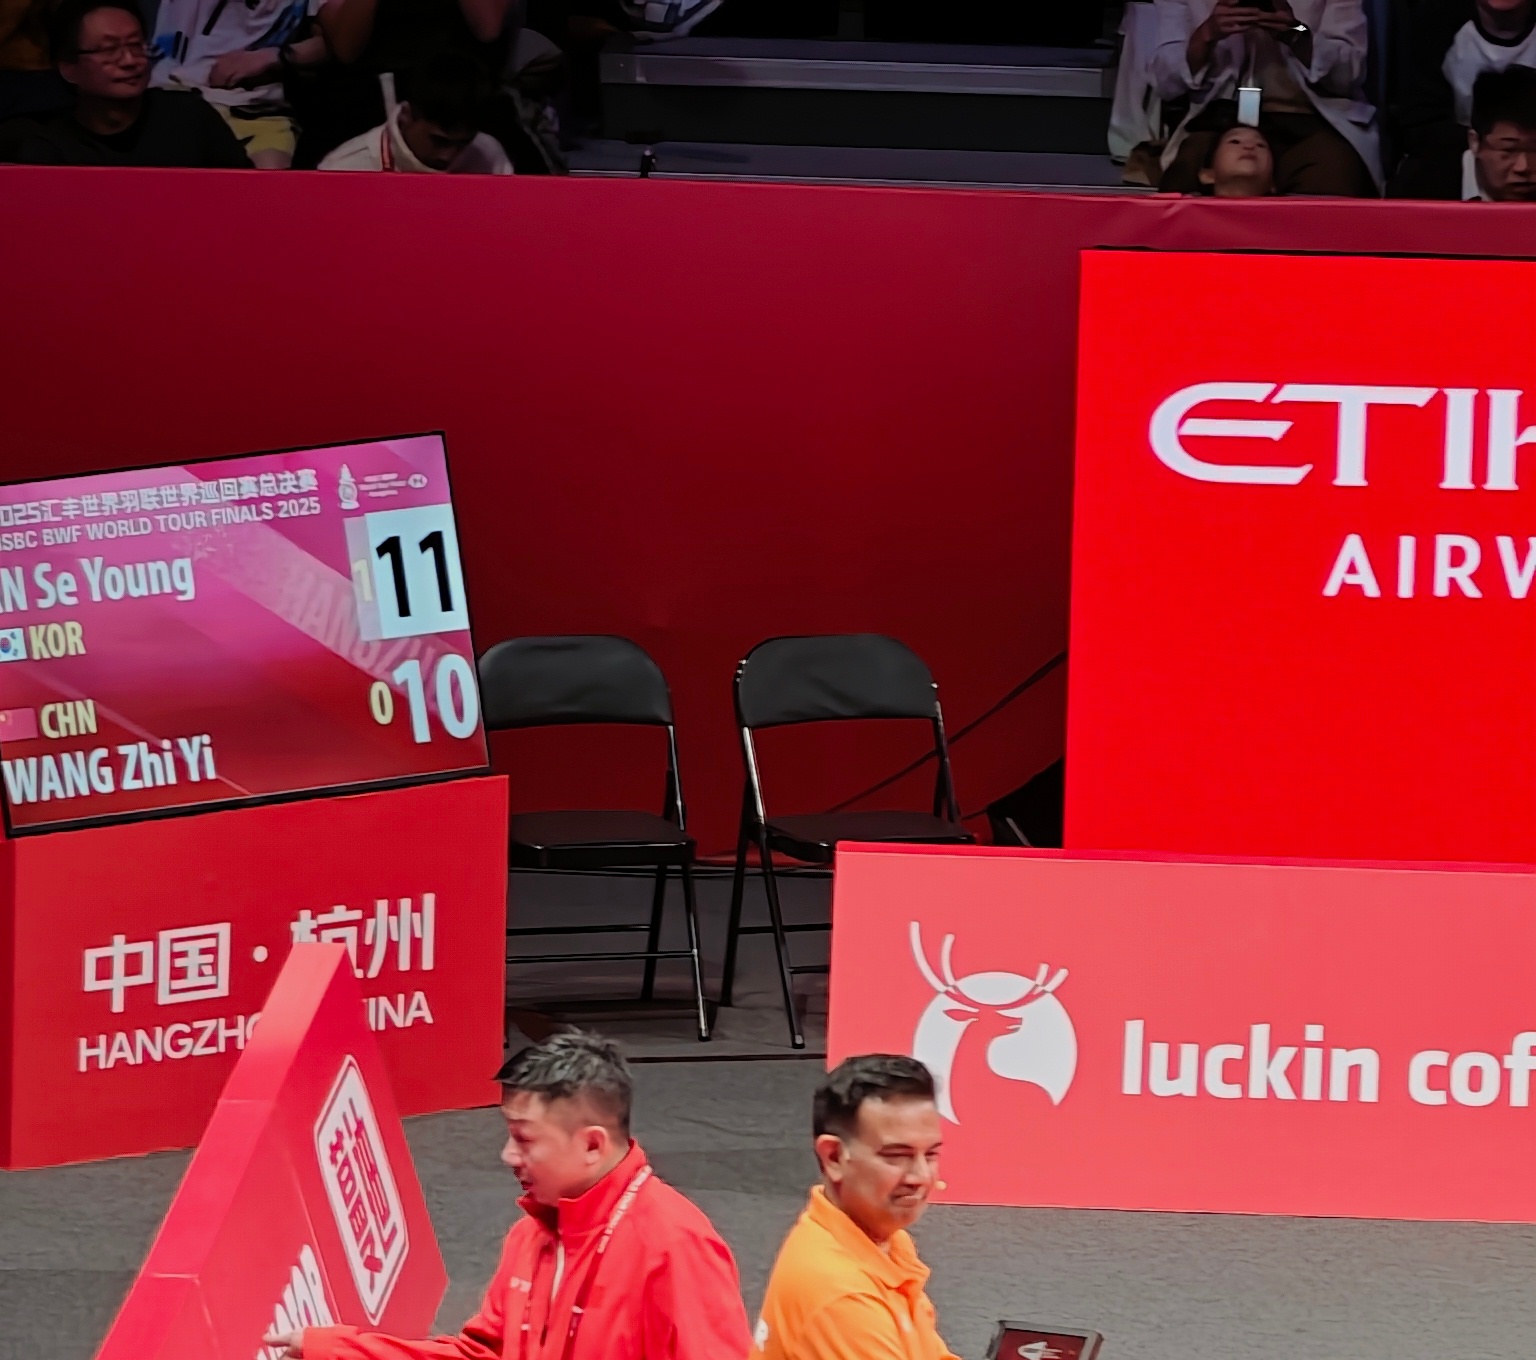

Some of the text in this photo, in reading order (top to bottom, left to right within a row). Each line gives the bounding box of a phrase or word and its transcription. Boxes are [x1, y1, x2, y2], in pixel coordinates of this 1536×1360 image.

[42, 524, 82, 546] BWF
[86, 517, 153, 541] WORLD
[155, 509, 208, 534] TOUR
[212, 502, 275, 526] FINALS
[277, 496, 321, 519] 2025
[35, 562, 78, 607] Se
[79, 556, 196, 603] Young
[375, 530, 455, 618] 11
[29, 621, 86, 660] KOR
[40, 699, 98, 739] CHN
[369, 653, 479, 745] 0 10
[0, 734, 217, 806] WANG Zhi Yi
[84, 893, 436, 1013] 中国·杭州
[78, 991, 434, 1073] HANGZH INA
[1122, 1018, 1380, 1104] luckin
